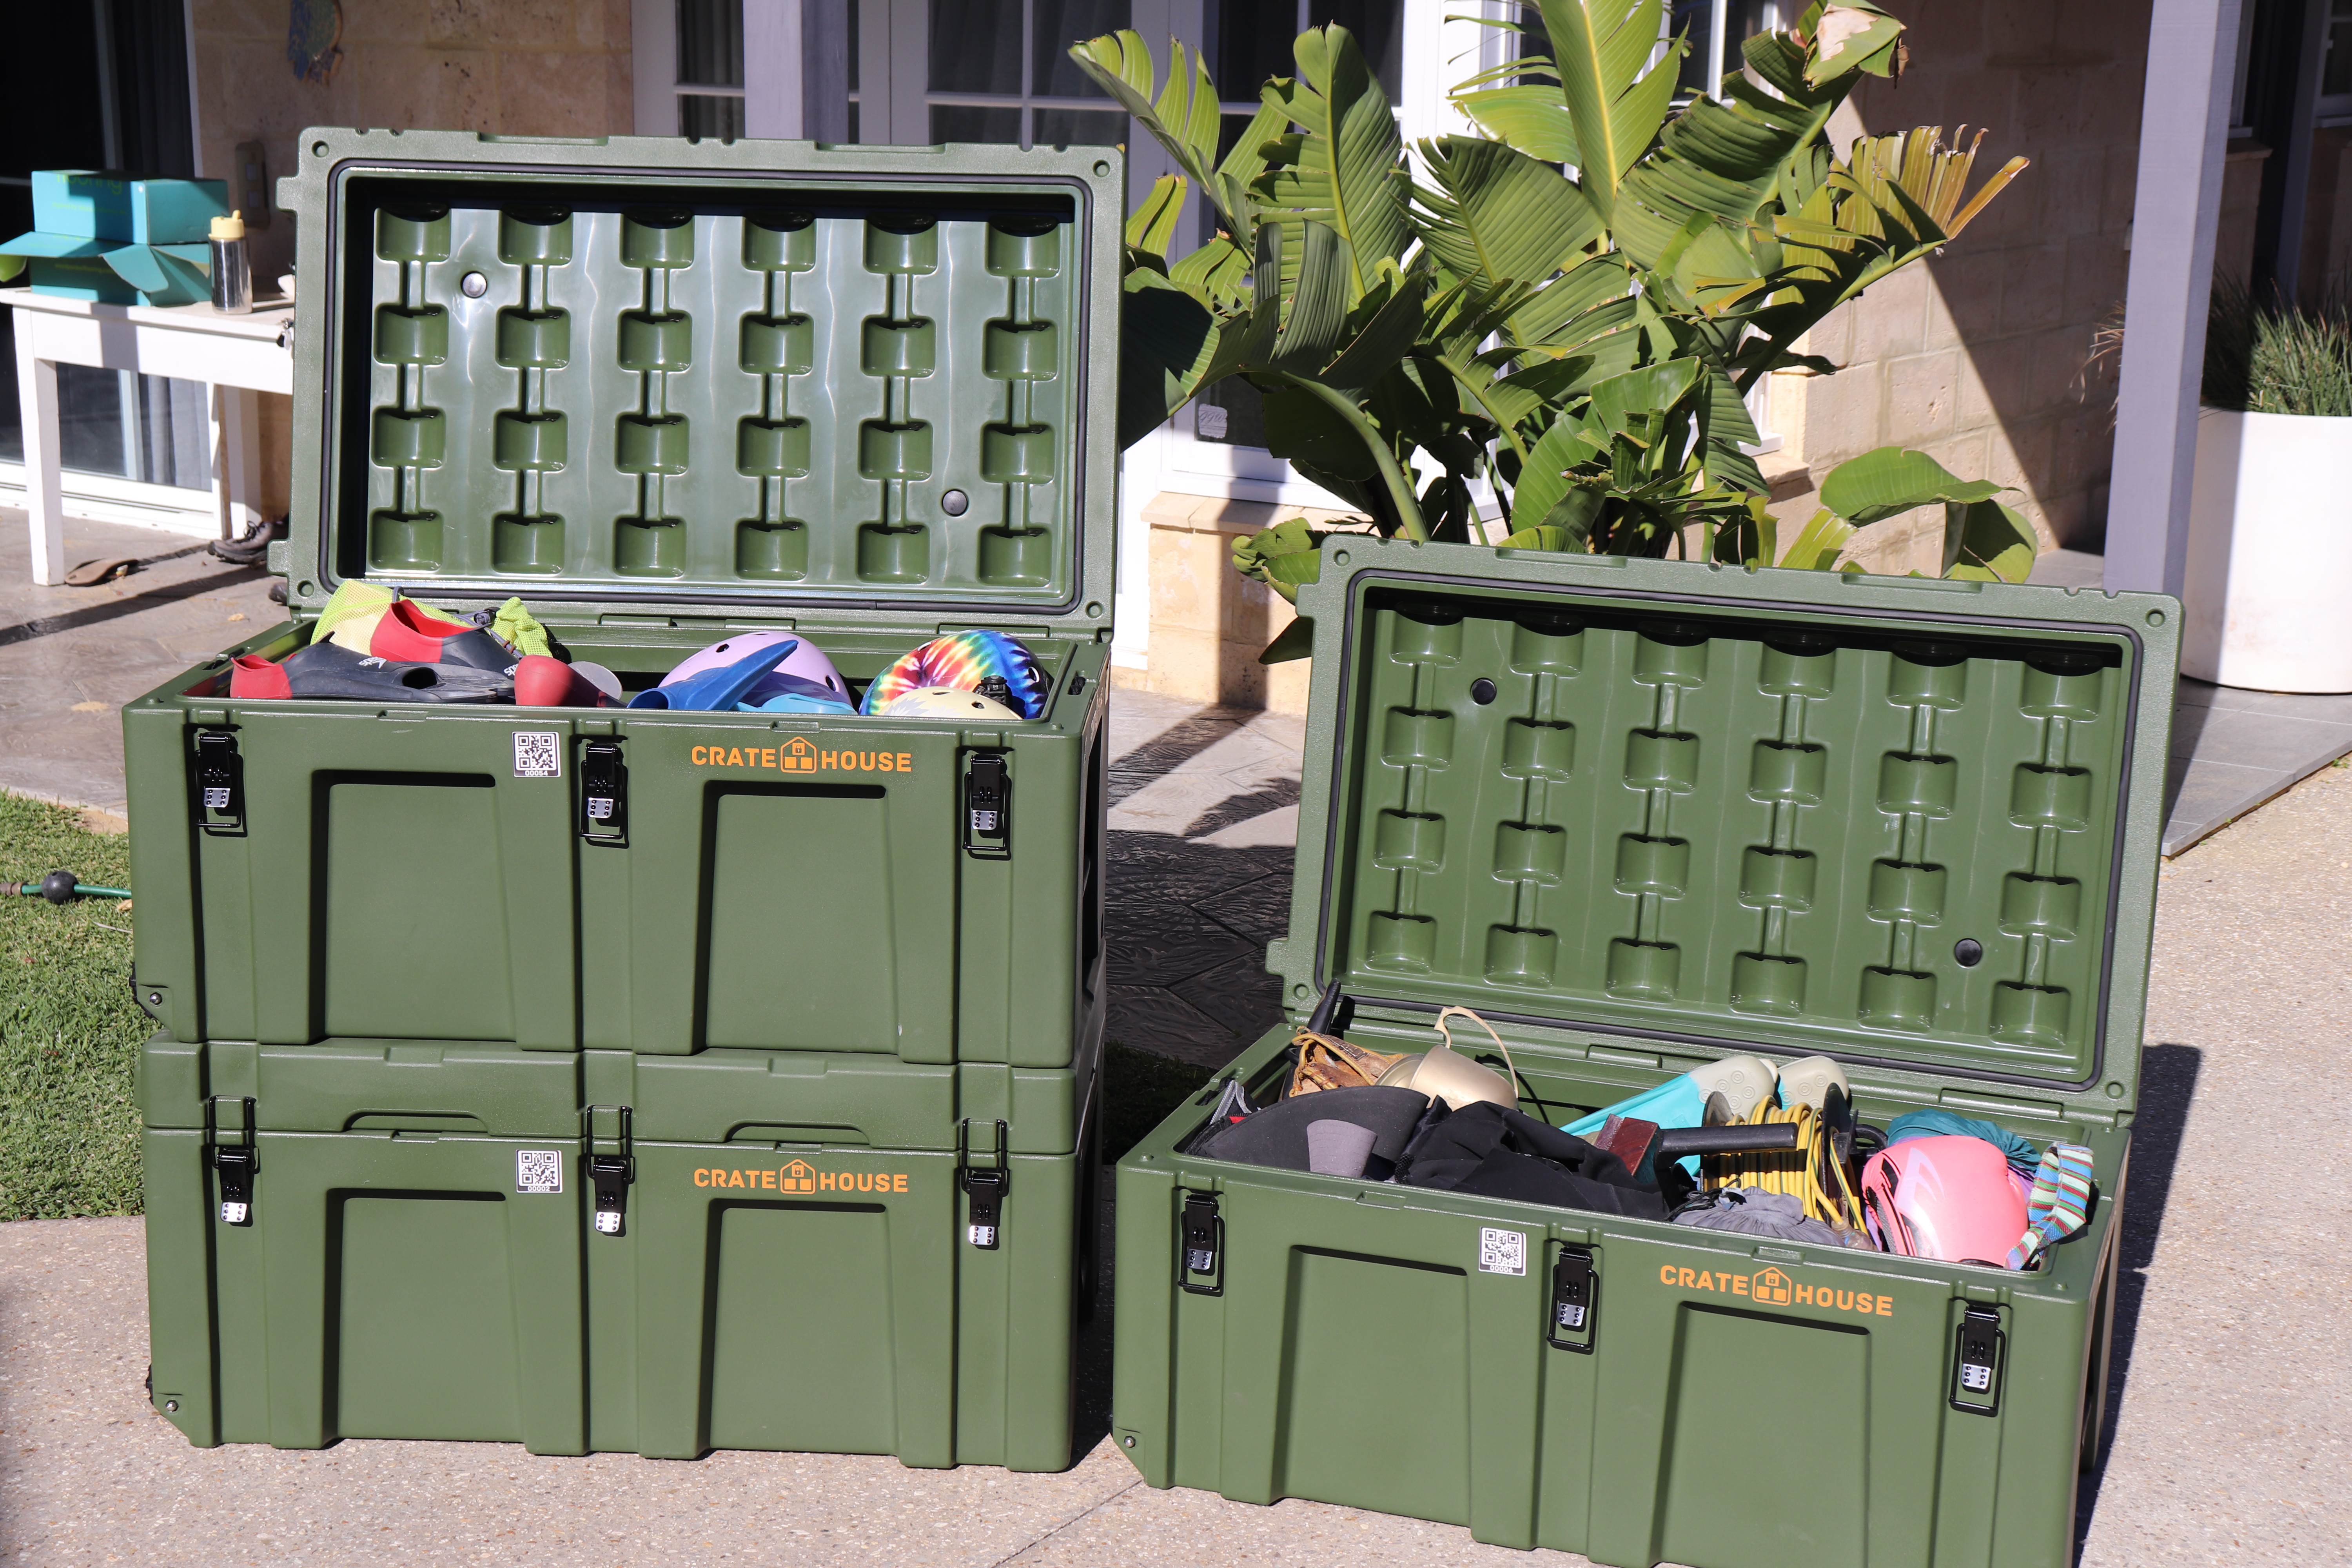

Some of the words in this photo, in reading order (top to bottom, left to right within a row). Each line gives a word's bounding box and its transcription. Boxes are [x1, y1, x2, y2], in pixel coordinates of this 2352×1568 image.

[691, 746, 778, 768] CRATE
[821, 750, 913, 772] HOUSE
[693, 1168, 778, 1189] CRATE
[820, 1172, 909, 1192] HOUSE
[1490, 1265, 1514, 1273] 00006
[1660, 1265, 1749, 1295] CRATE
[1795, 1284, 1894, 1316] HOUSE
